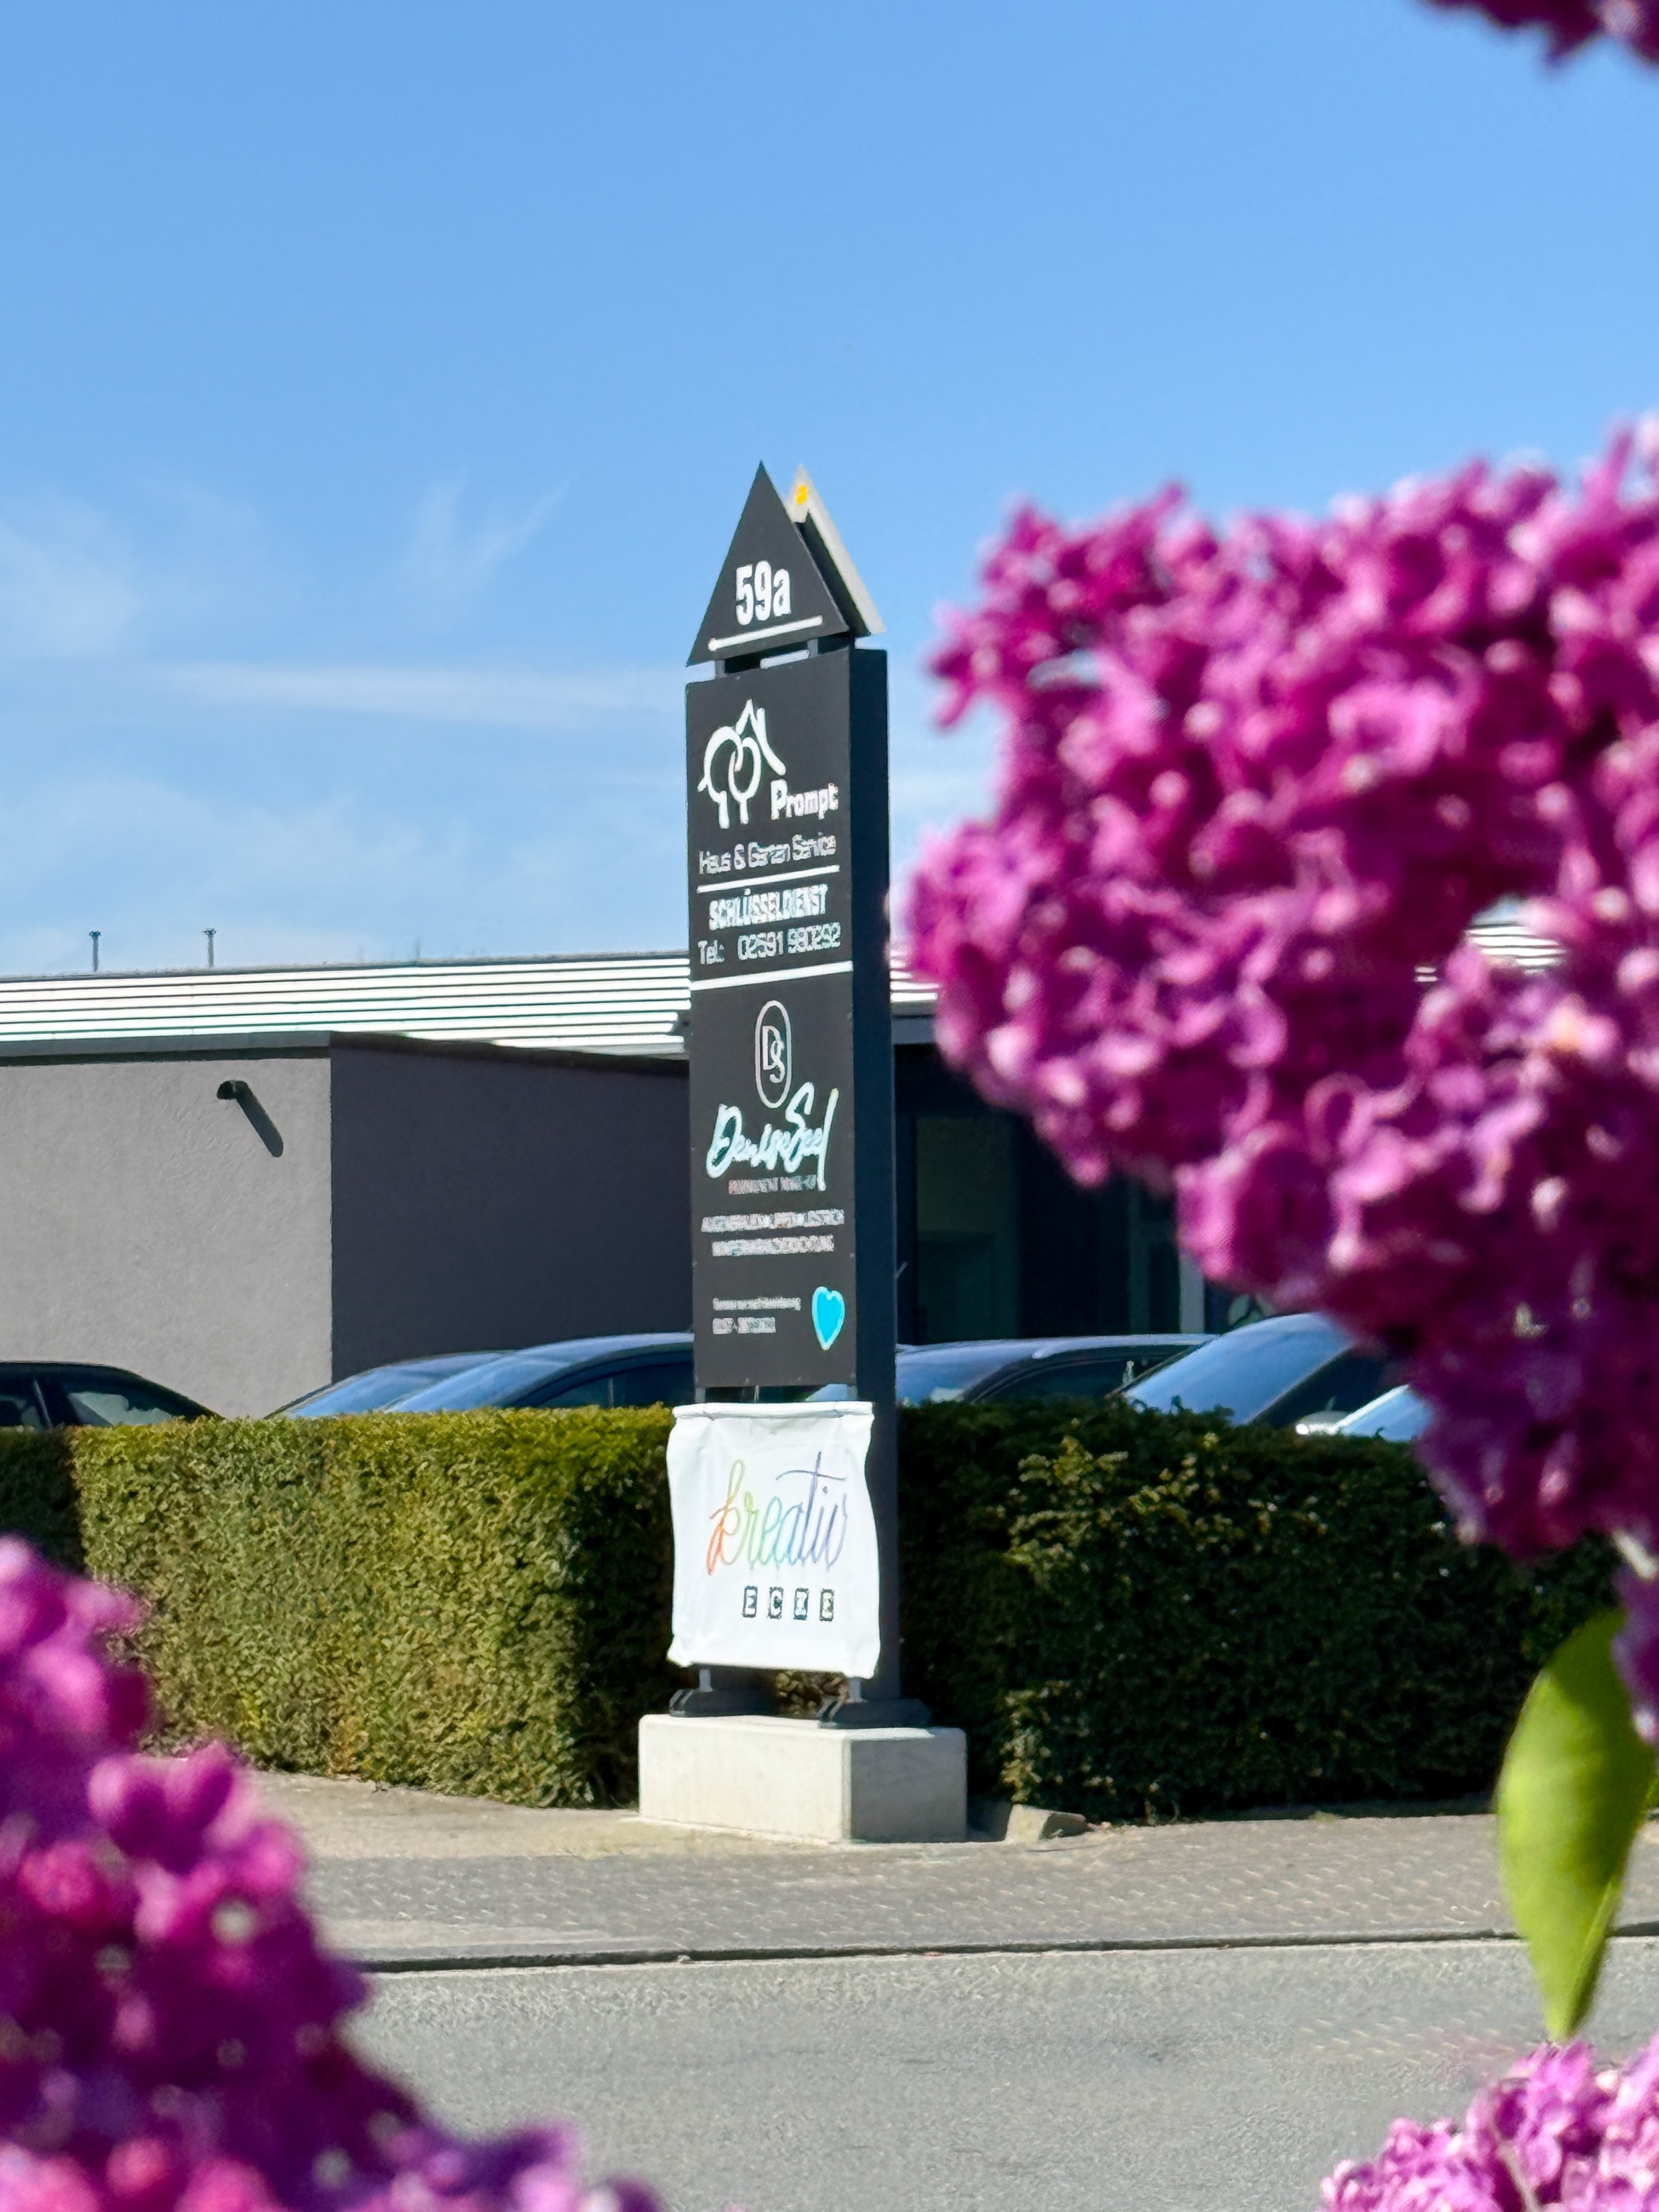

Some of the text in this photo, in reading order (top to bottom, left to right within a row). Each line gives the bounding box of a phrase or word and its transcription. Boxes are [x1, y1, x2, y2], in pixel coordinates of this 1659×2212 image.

[735, 560, 792, 626] 59a
[770, 779, 839, 820] Prompt
[699, 850, 731, 874] Haus
[792, 833, 837, 861] Service
[709, 884, 829, 931] SCHLÜSSELDIENST
